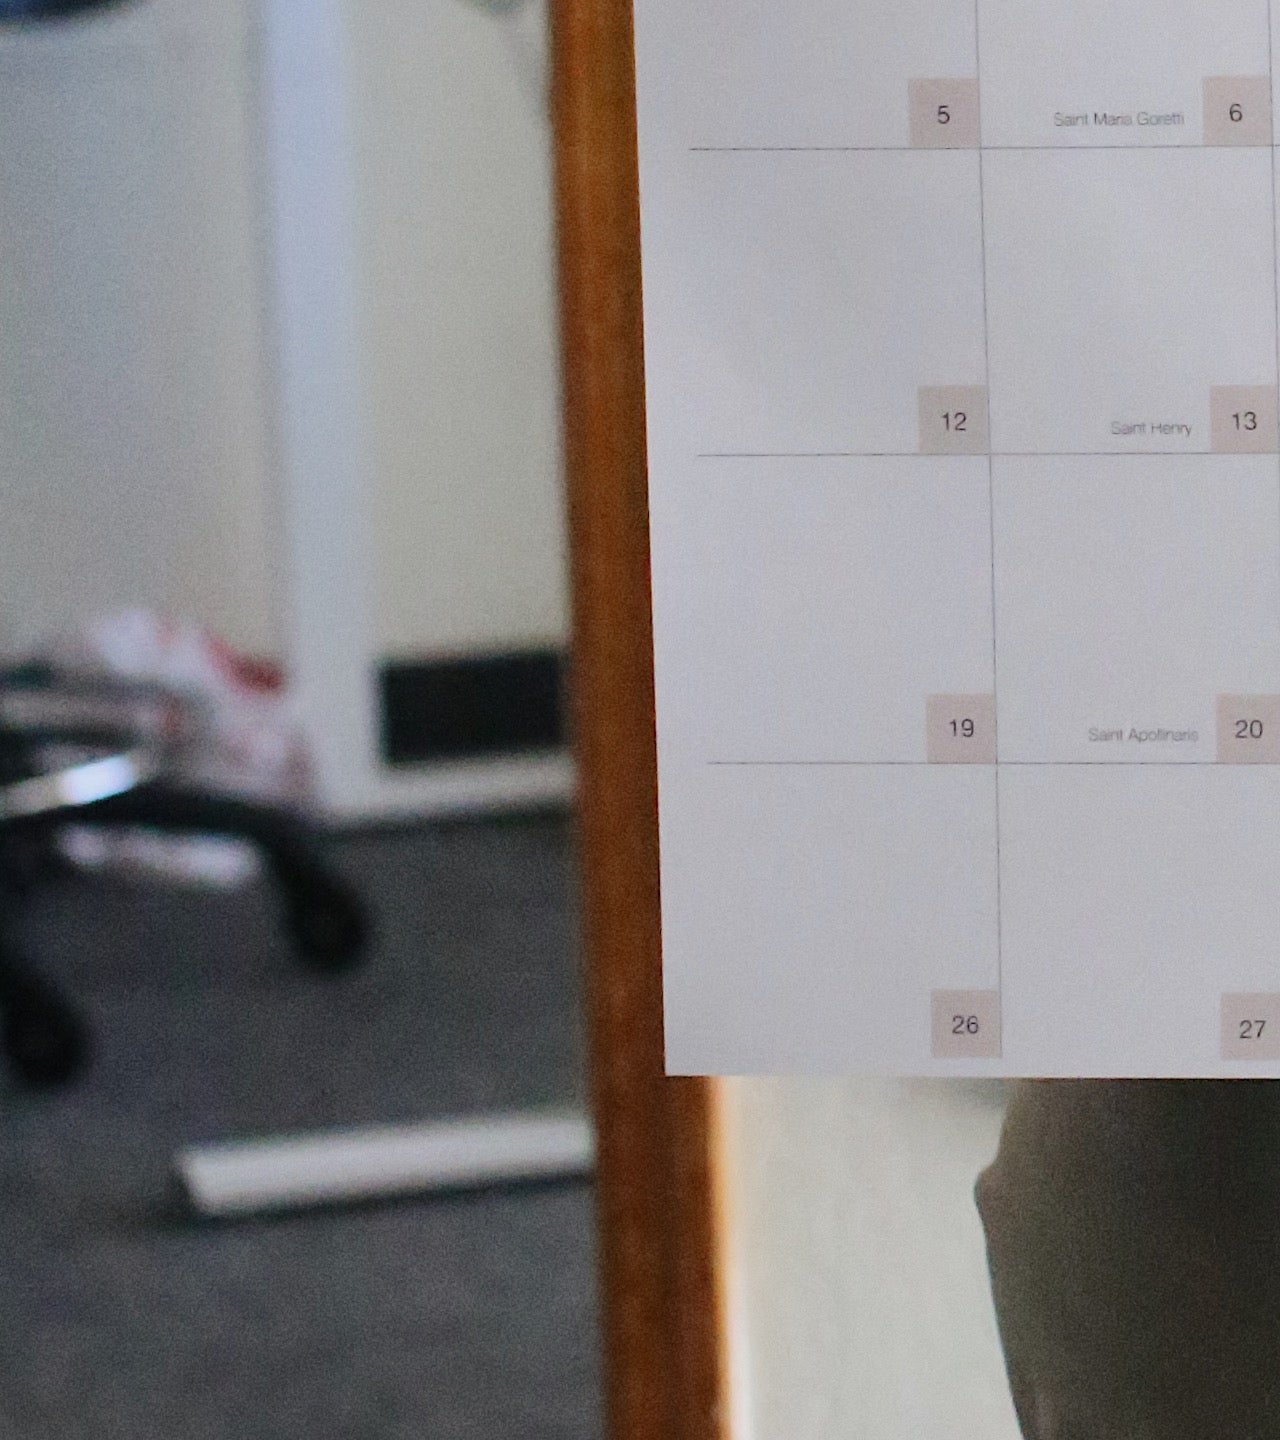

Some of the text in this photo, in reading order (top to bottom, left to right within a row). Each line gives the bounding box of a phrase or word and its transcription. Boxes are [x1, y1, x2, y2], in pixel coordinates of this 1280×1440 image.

[937, 104, 951, 125] 5
[1054, 111, 1089, 128] Saint
[1228, 102, 1244, 123] 6
[942, 411, 967, 432] 12
[1111, 420, 1192, 437] Saint Henry
[1232, 410, 1258, 431] 13
[949, 718, 975, 738] 19
[1088, 728, 1124, 742] Saint
[1234, 719, 1264, 740] 20
[951, 1014, 980, 1035] 26
[1239, 1019, 1267, 1040] 27
